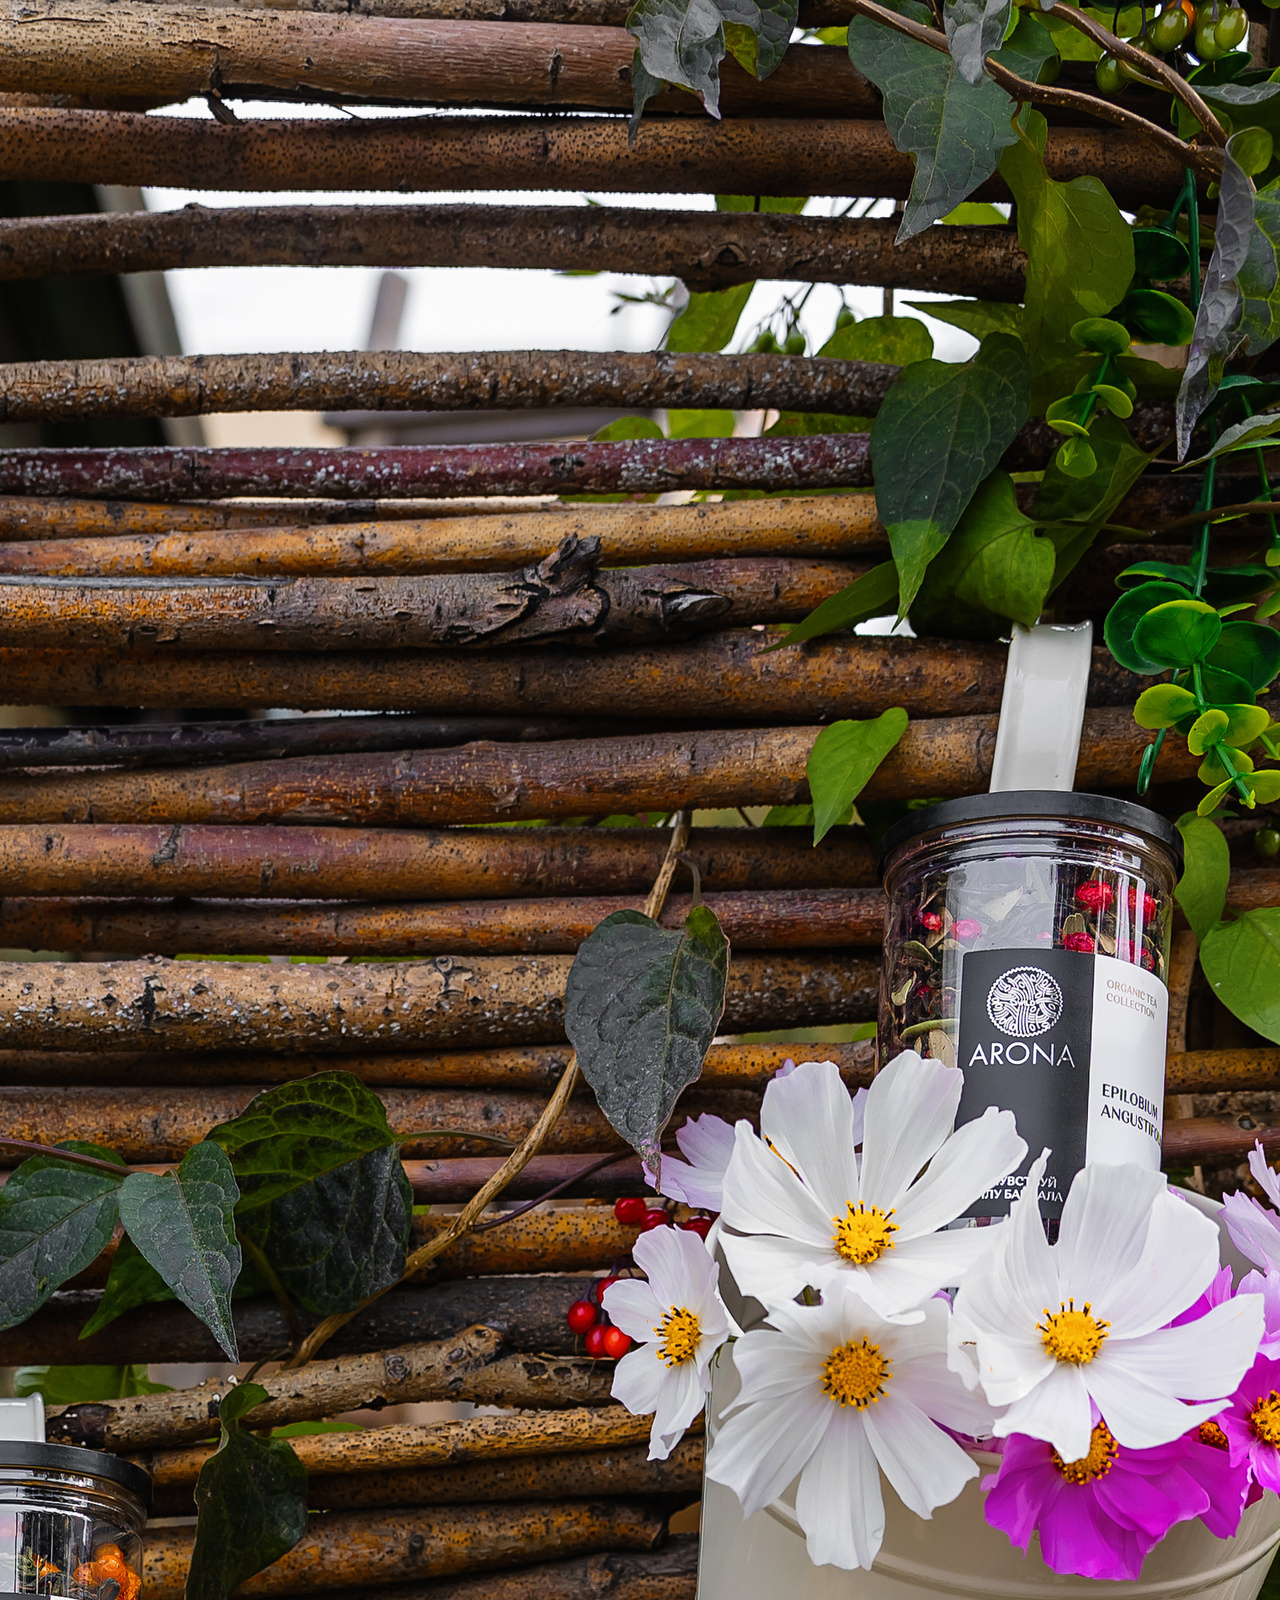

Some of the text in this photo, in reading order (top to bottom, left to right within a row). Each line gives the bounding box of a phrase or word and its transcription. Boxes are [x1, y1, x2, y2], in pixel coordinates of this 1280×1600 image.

[1106, 979, 1158, 1009] ORGANIC TEA
[1106, 991, 1156, 1020] COLLECTION
[968, 1041, 1076, 1069] ARONA
[1102, 1083, 1158, 1121] EPILOBIUM
[1100, 1103, 1161, 1147] ANGUSTIFO
[996, 1175, 1057, 1189] УВСТУЙ
[1004, 1189, 1064, 1202] БААЛА
